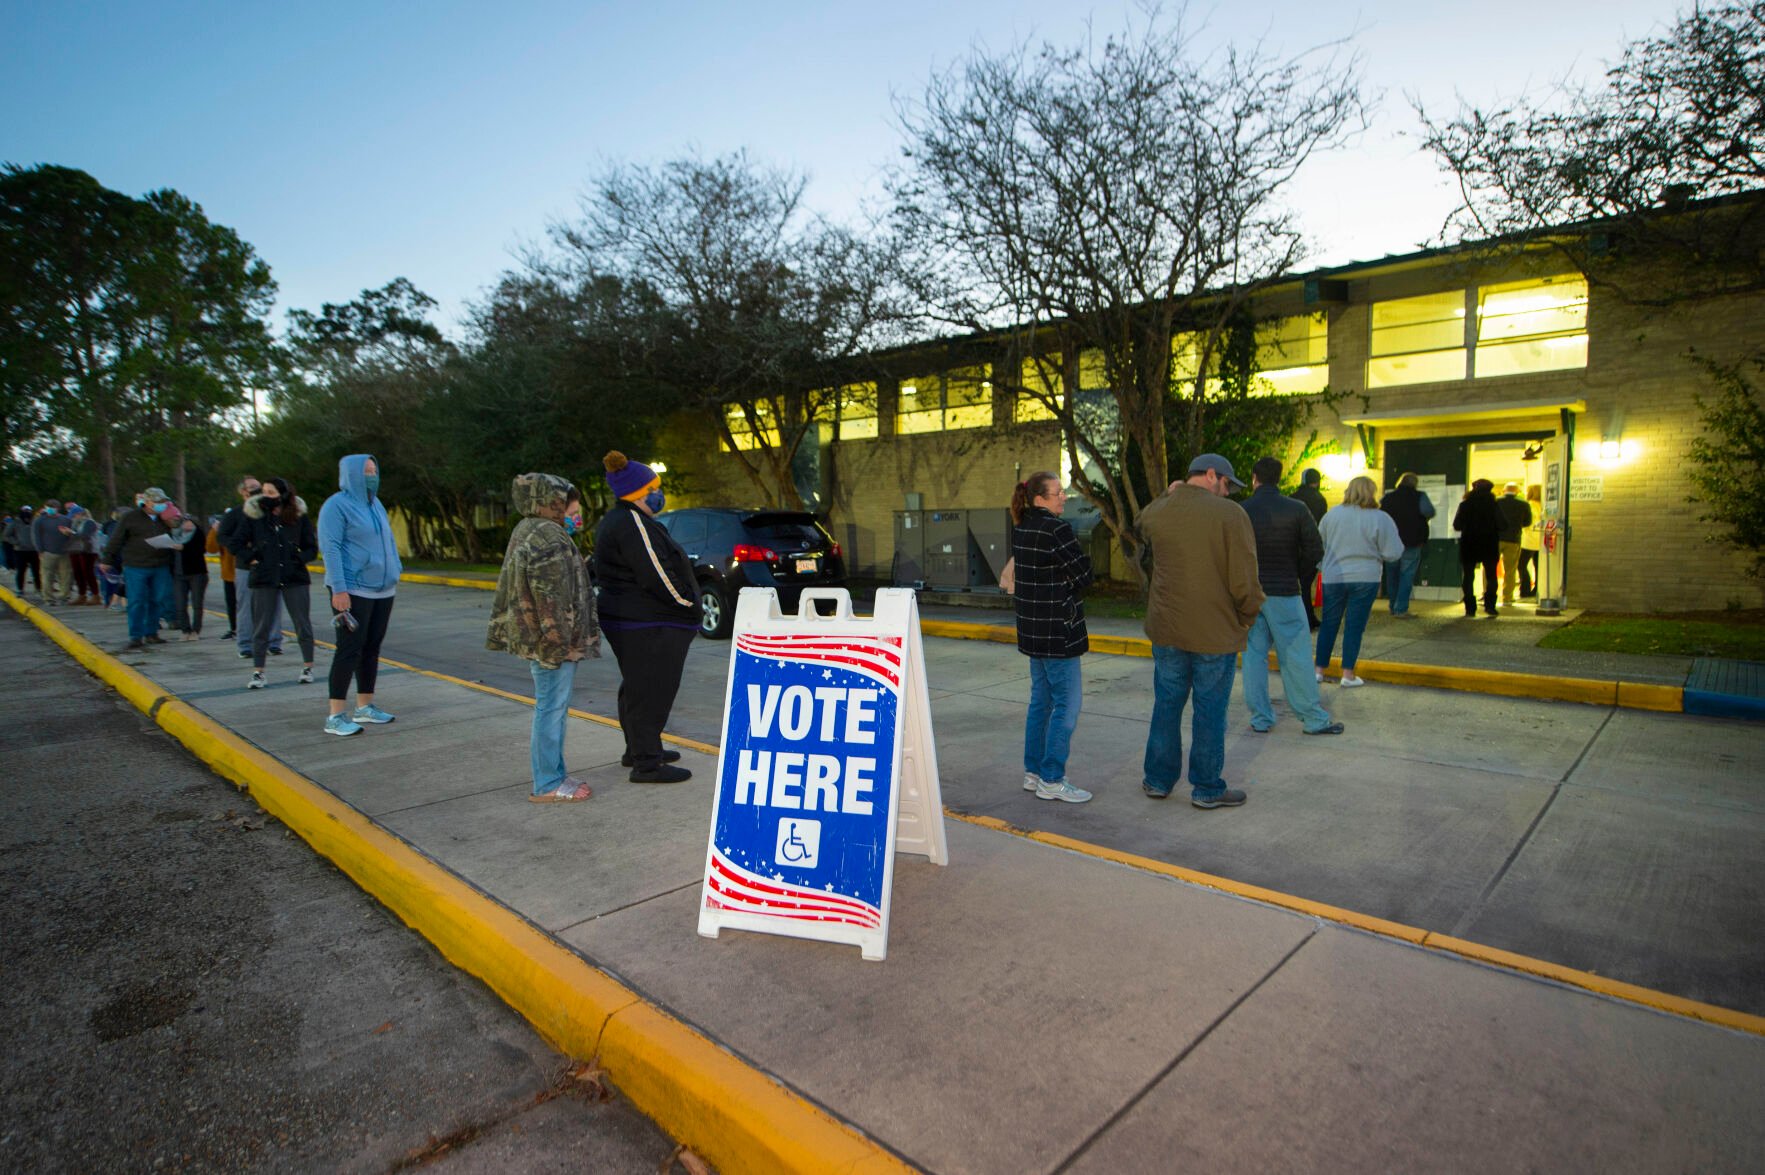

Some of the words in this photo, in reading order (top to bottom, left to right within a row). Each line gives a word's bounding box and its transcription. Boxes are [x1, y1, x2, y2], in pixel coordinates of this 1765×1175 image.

[941, 512, 961, 521] YORK
[747, 684, 878, 744] VOTE
[733, 750, 877, 815] HERE
